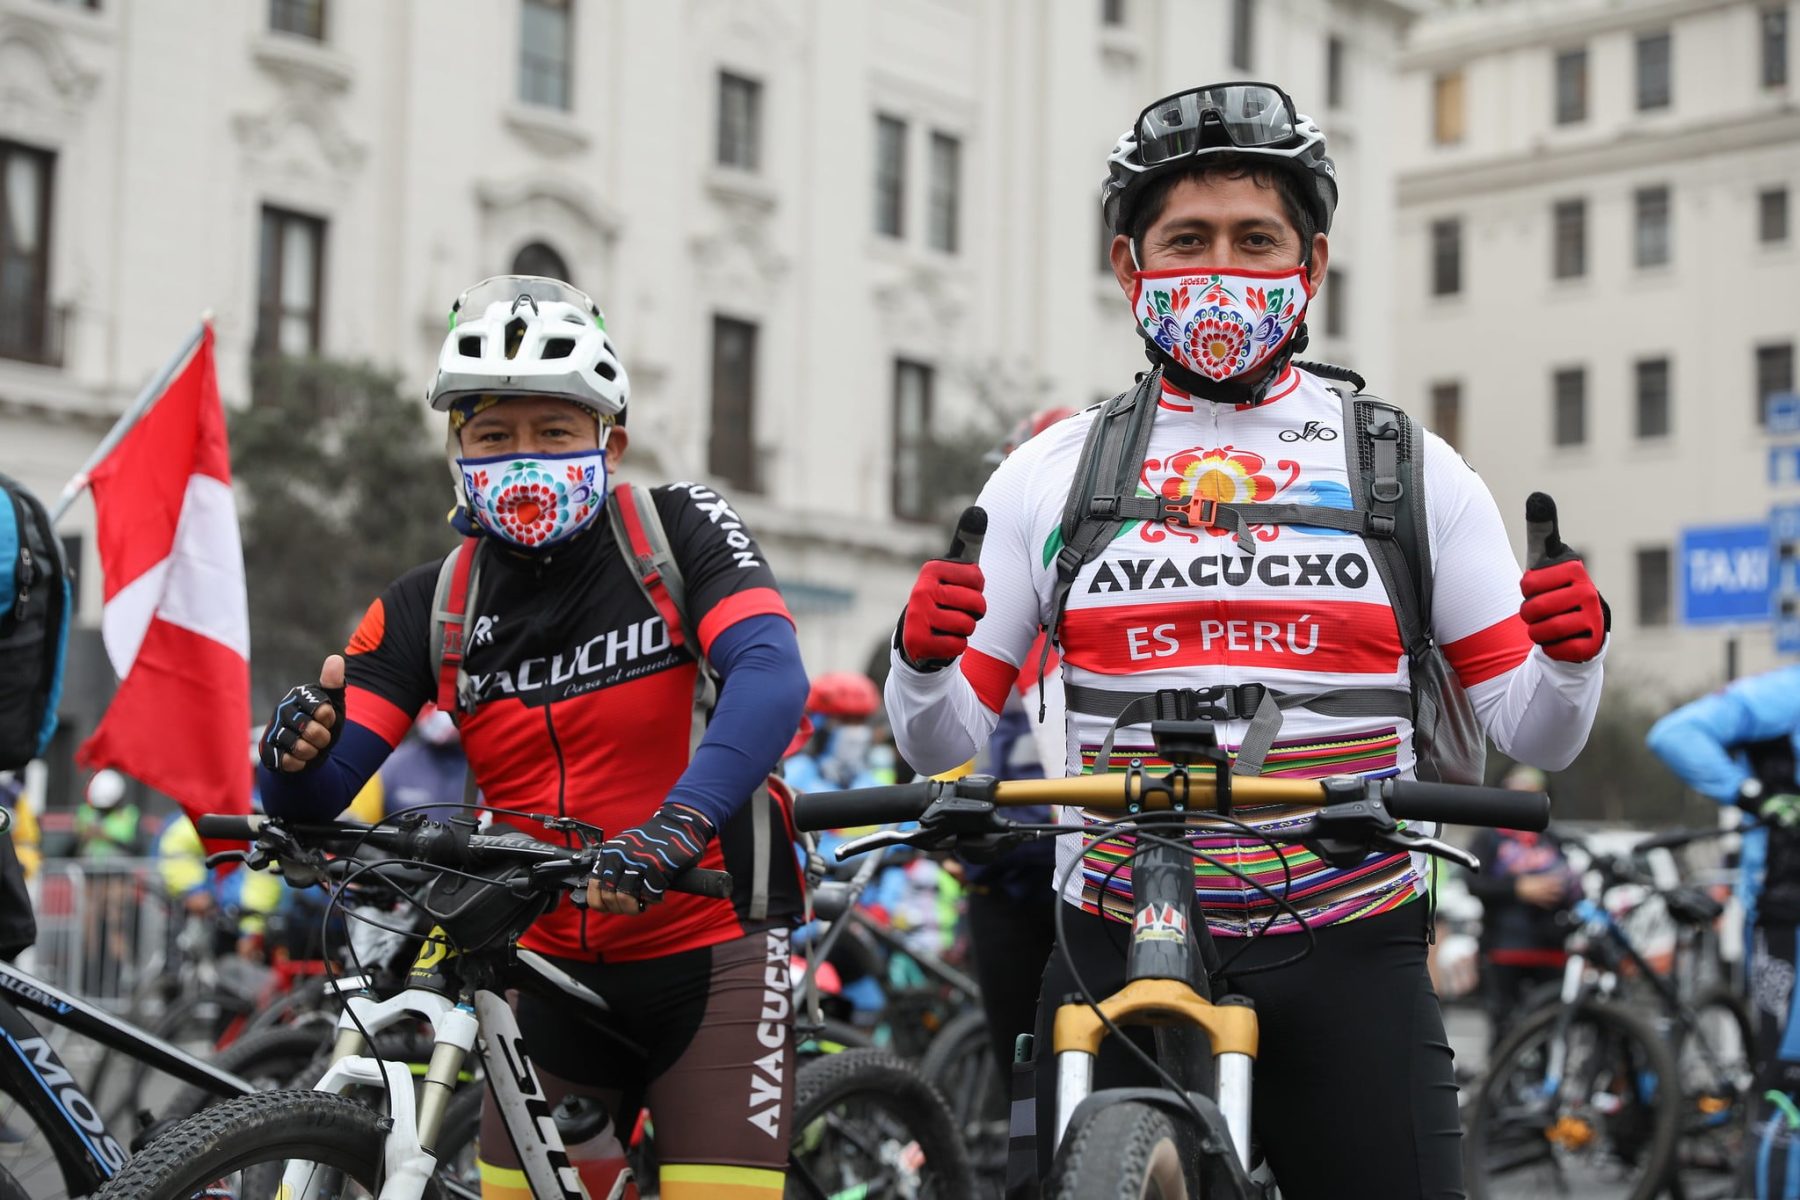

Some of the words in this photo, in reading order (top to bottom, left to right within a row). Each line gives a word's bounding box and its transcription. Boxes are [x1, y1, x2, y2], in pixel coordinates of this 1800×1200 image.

[1087, 552, 1370, 594] AYACUCHO
[1690, 547, 1769, 593] TAXI
[468, 615, 673, 699] YACUCHO
[1126, 623, 1180, 661] ES
[1199, 614, 1320, 656] PERÚ
[563, 679, 602, 697] Para
[626, 653, 680, 678] mundo
